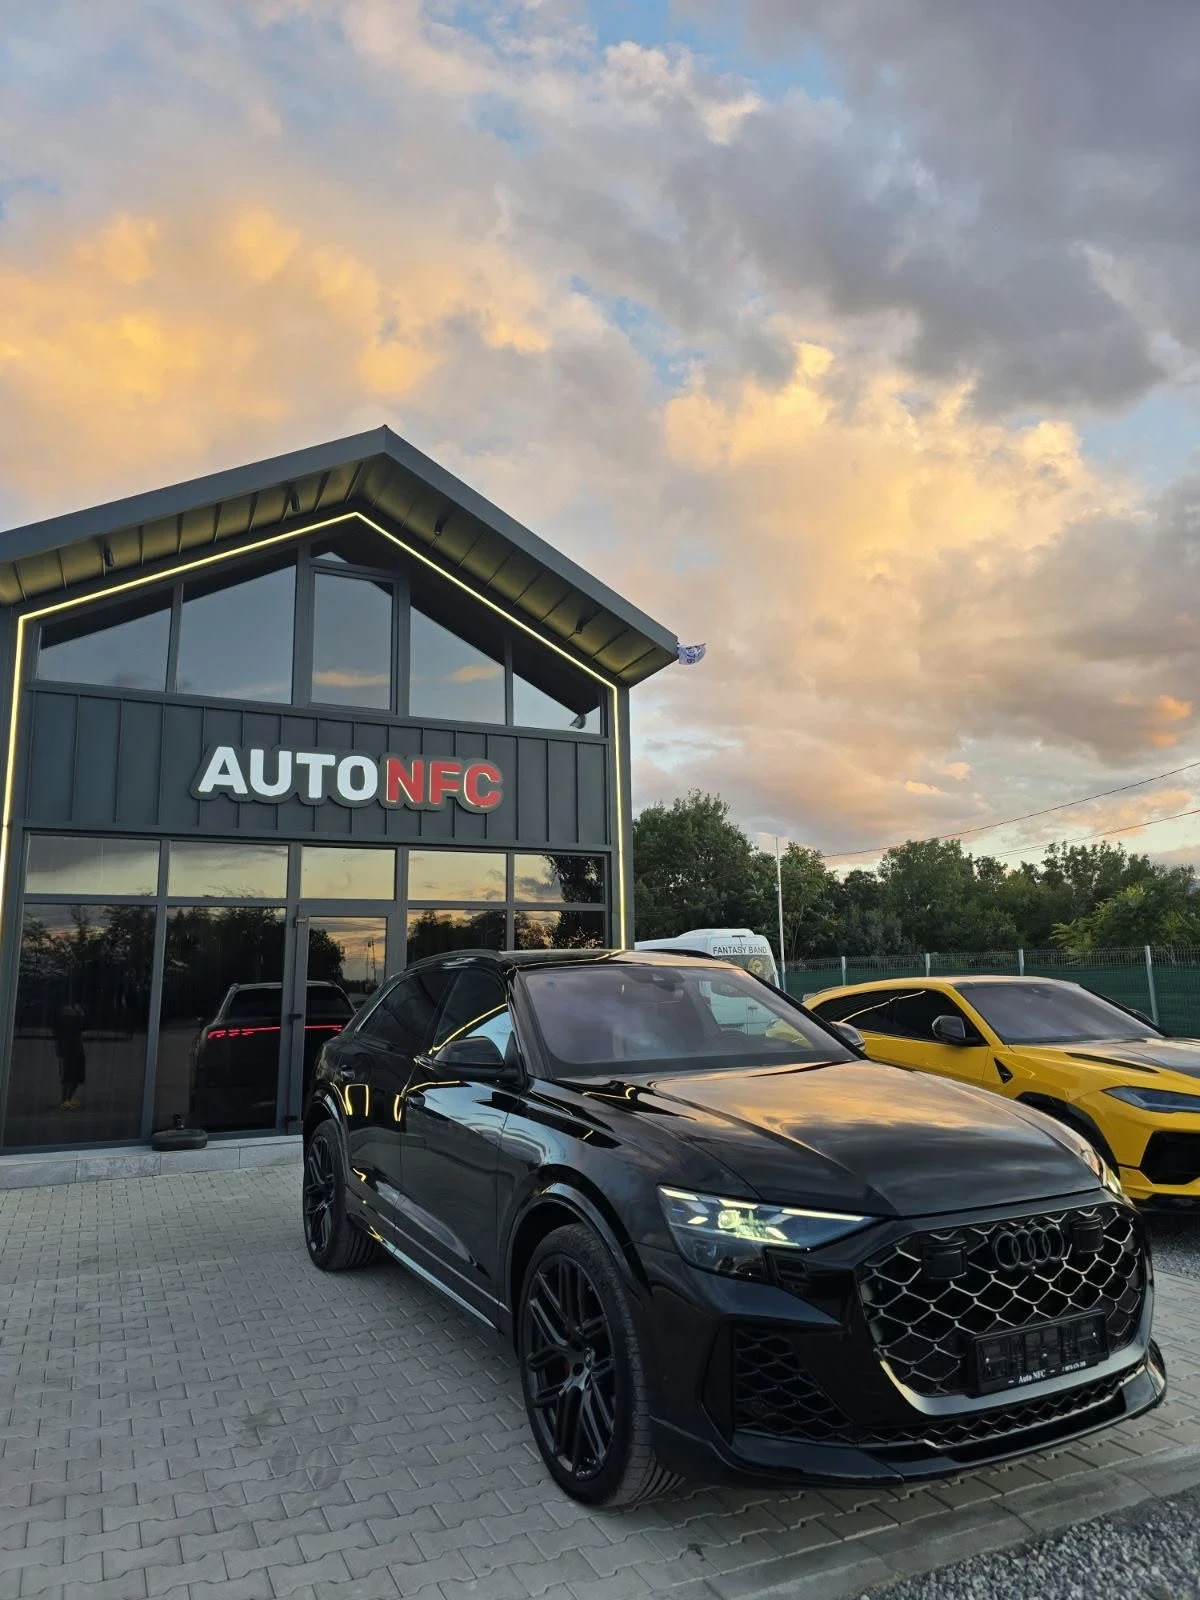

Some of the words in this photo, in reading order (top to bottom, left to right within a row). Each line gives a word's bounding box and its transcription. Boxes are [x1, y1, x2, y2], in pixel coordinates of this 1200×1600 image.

[713, 946, 747, 955] FANTASY
[748, 946, 767, 954] BAND
[1018, 1374, 1033, 1384] Auto
[1032, 1369, 1046, 1379] NFC
